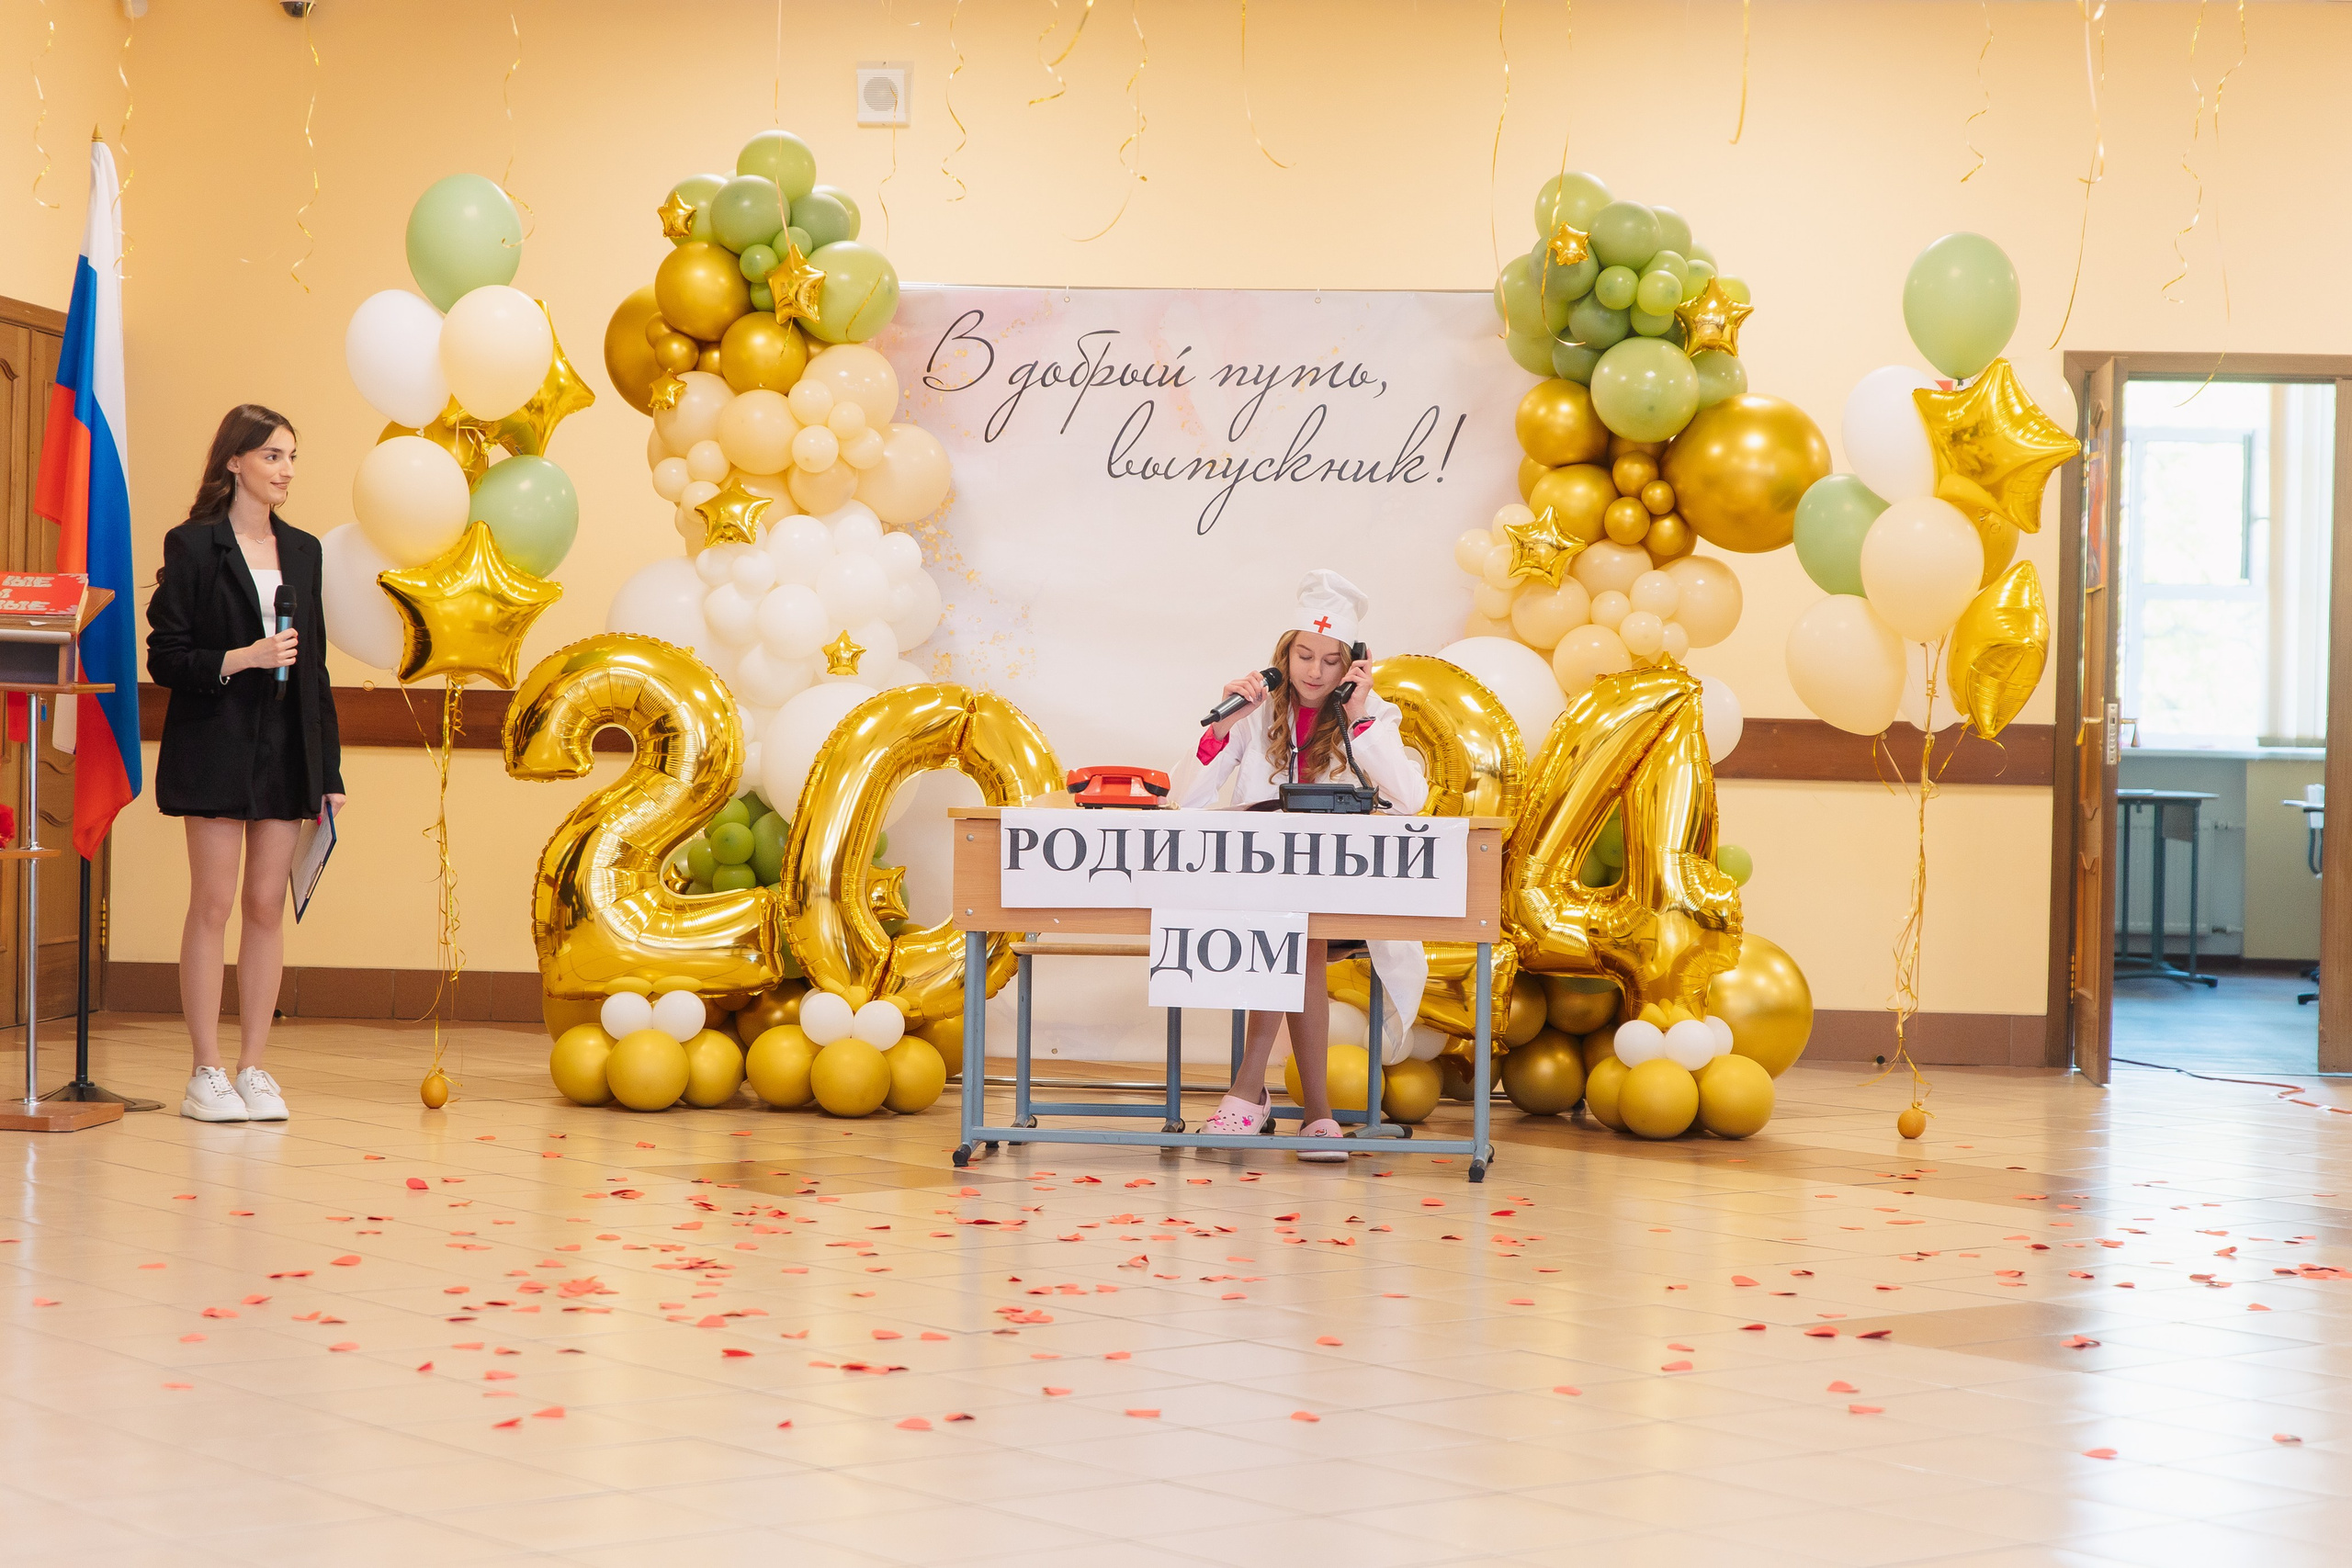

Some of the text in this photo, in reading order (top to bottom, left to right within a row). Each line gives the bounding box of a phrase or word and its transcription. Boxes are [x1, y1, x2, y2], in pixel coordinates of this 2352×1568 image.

[922, 309, 1387, 444] В добрый путь,
[1107, 400, 1467, 536] выпускник!
[1003, 823, 1439, 883] РОДИЛЬНЫЙ
[1149, 927, 1304, 981] ДОМ
